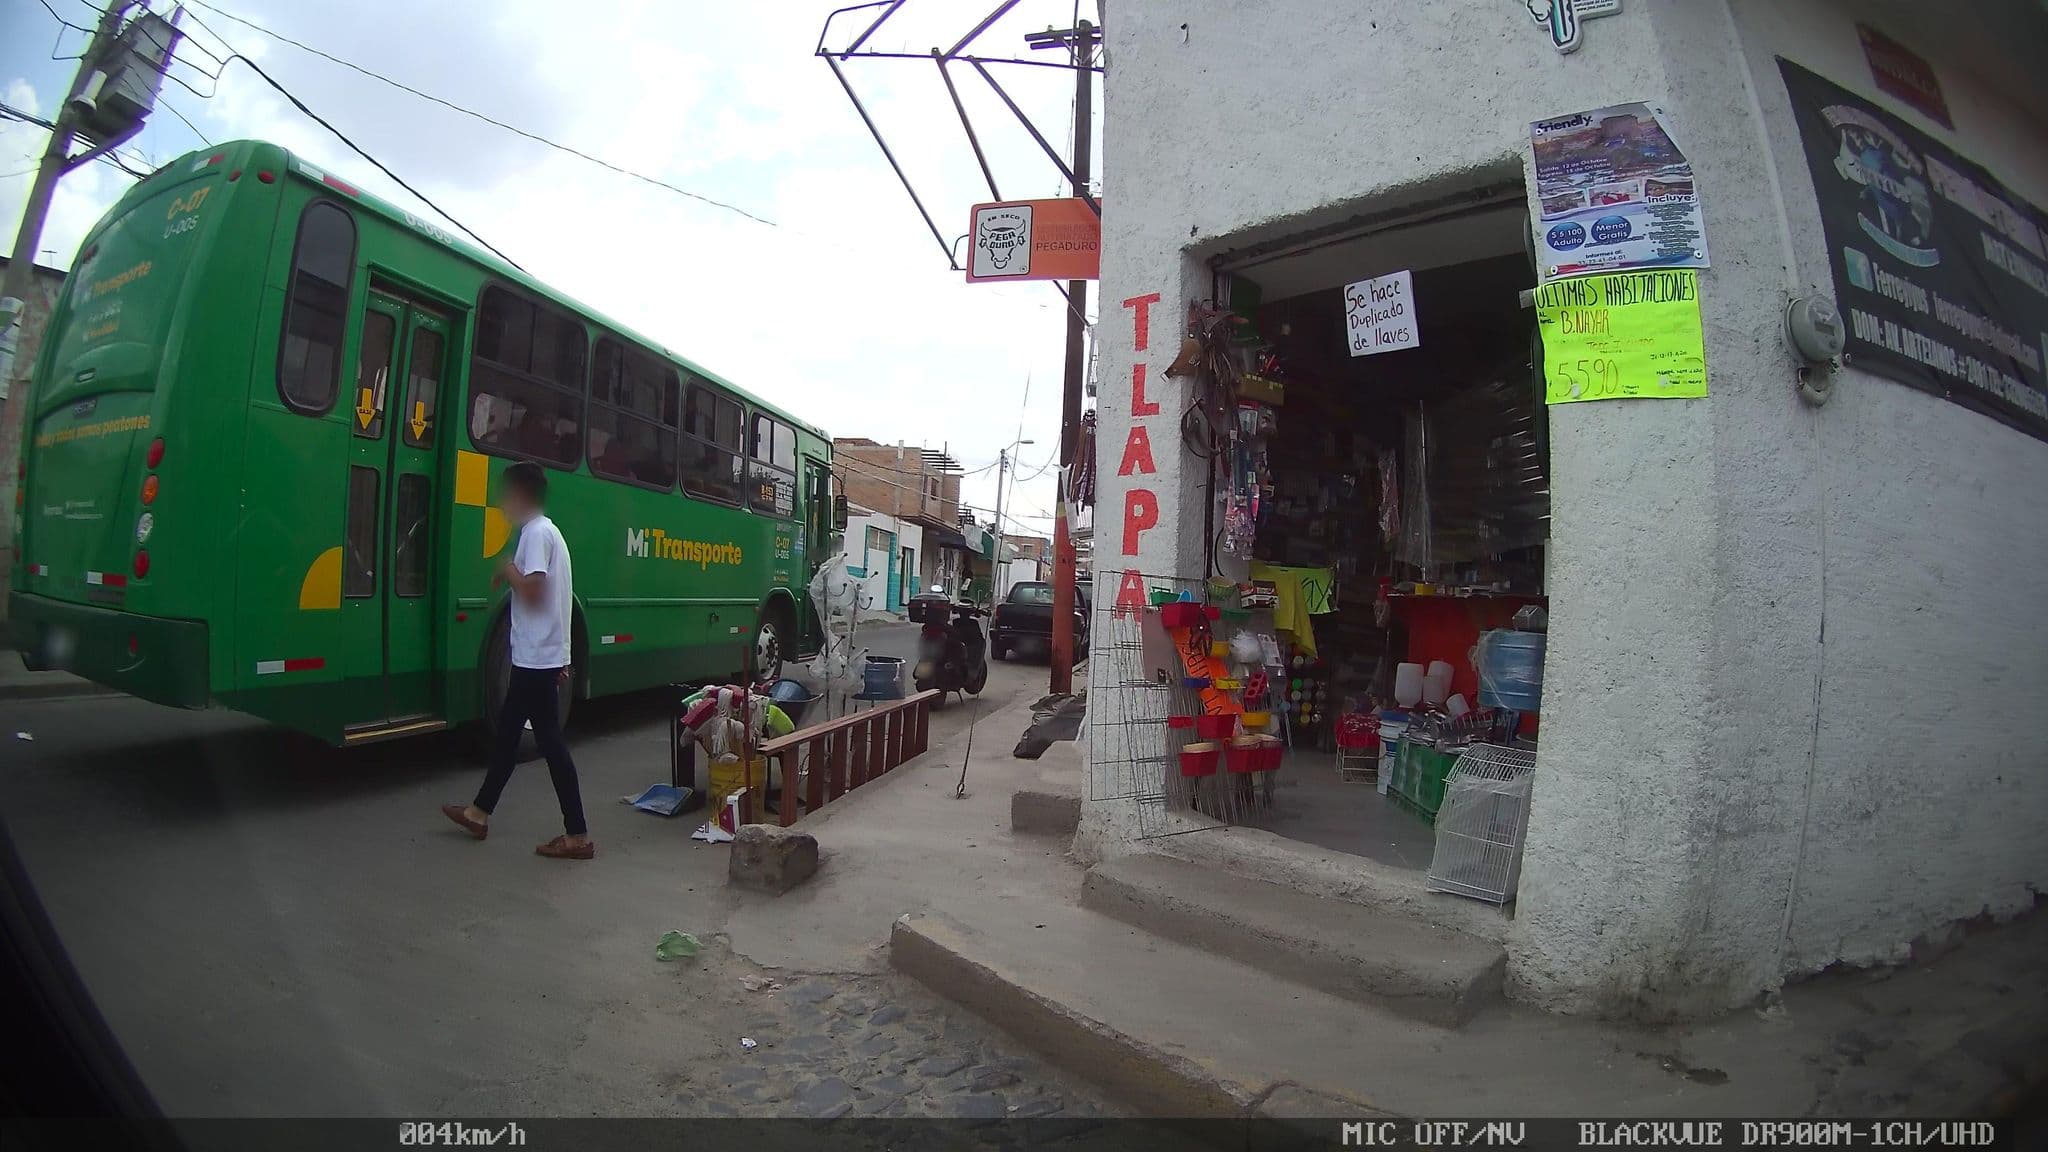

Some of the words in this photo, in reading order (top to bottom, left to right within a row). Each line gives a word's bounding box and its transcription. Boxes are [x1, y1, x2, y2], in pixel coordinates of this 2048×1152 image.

[168, 186, 210, 220] C-07
[1648, 194, 1695, 203] Incluye:
[163, 215, 199, 239] U-005
[1596, 222, 1628, 232] Menor
[1599, 230, 1628, 240] Gratis
[990, 231, 1016, 241] PEGA
[1553, 238, 1582, 247] Adulto
[990, 240, 1015, 249] DURO
[1036, 241, 1098, 251] PEGADURO
[1346, 285, 1367, 314] Se
[1370, 280, 1401, 302] hace
[1604, 272, 1695, 306] HABITACIONES
[1351, 301, 1404, 329] Duplicado
[1354, 333, 1369, 350] de
[1375, 327, 1409, 346] llaves
[627, 527, 649, 558] Mi
[653, 528, 742, 571] Transporte
